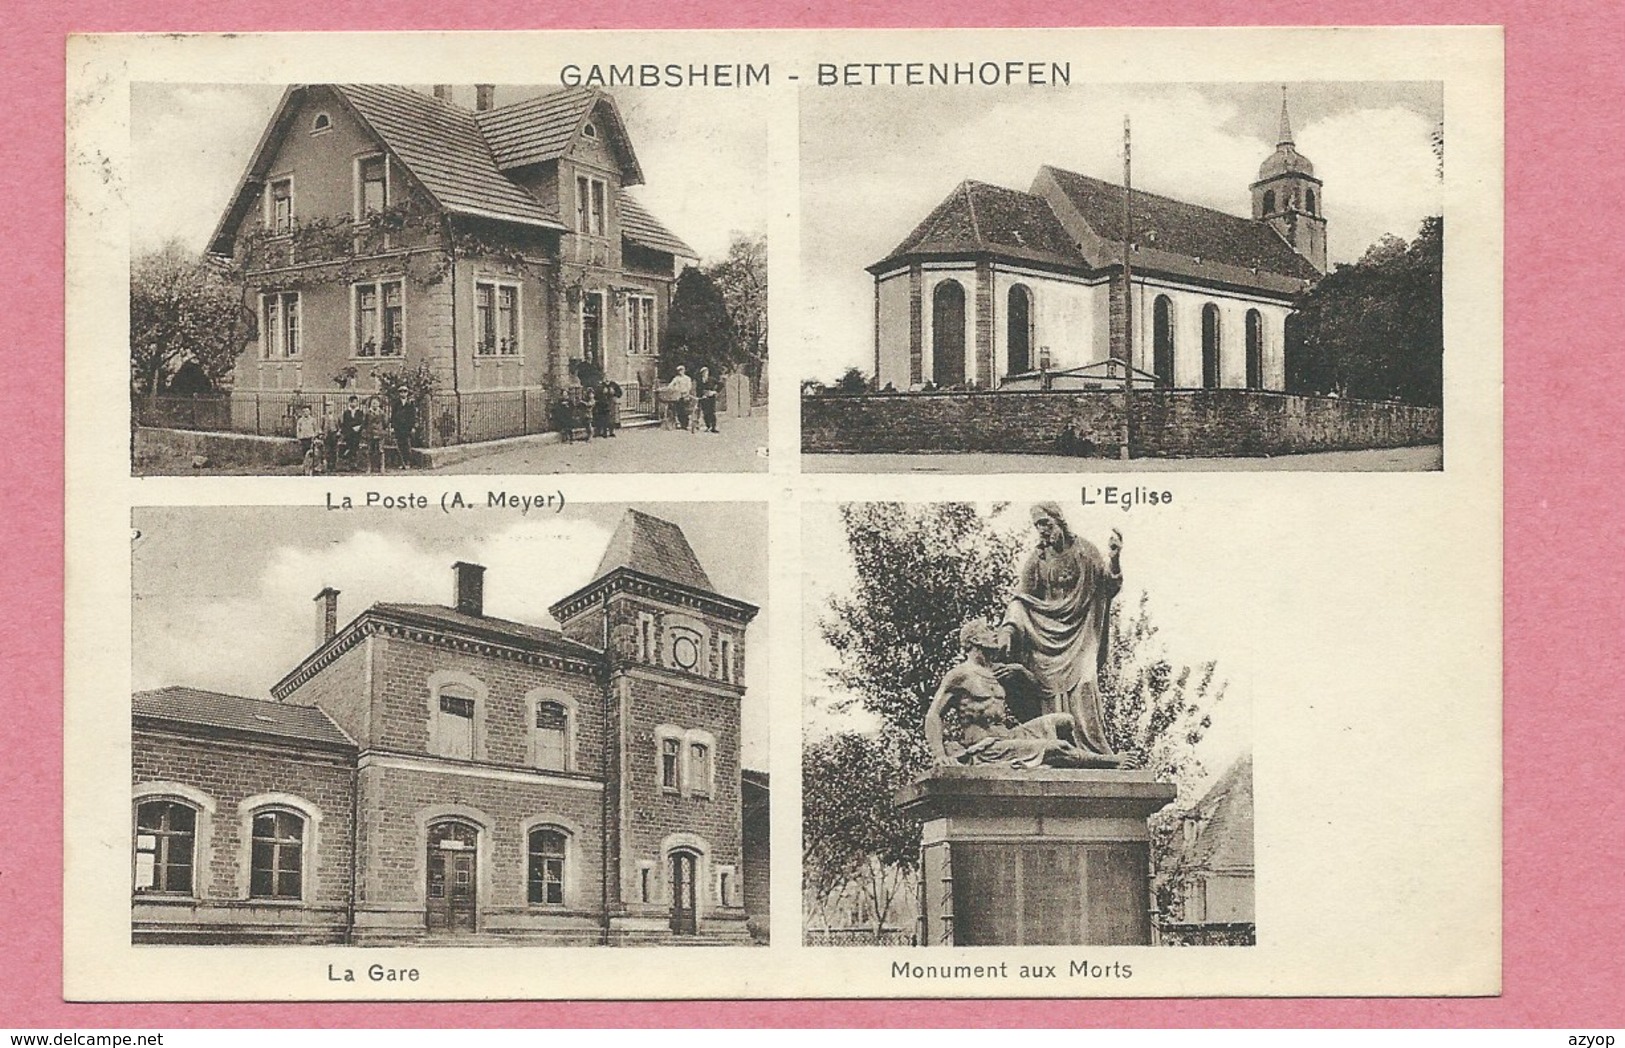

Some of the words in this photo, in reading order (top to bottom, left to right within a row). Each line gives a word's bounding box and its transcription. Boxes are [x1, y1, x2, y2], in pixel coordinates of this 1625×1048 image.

[560, 64, 770, 87] GAMBSHEIM
[818, 62, 1070, 87] BETTENHOFEN
[326, 491, 353, 510] La
[366, 491, 428, 509] Poste
[440, 491, 475, 513] (A.
[487, 490, 566, 514] Meyer)
[1081, 487, 1173, 510] L'Eglise
[328, 964, 355, 982] La
[368, 963, 420, 982] Gare
[891, 961, 1008, 979] Monument
[1019, 964, 1056, 979] aux
[1069, 961, 1133, 979] Morts
